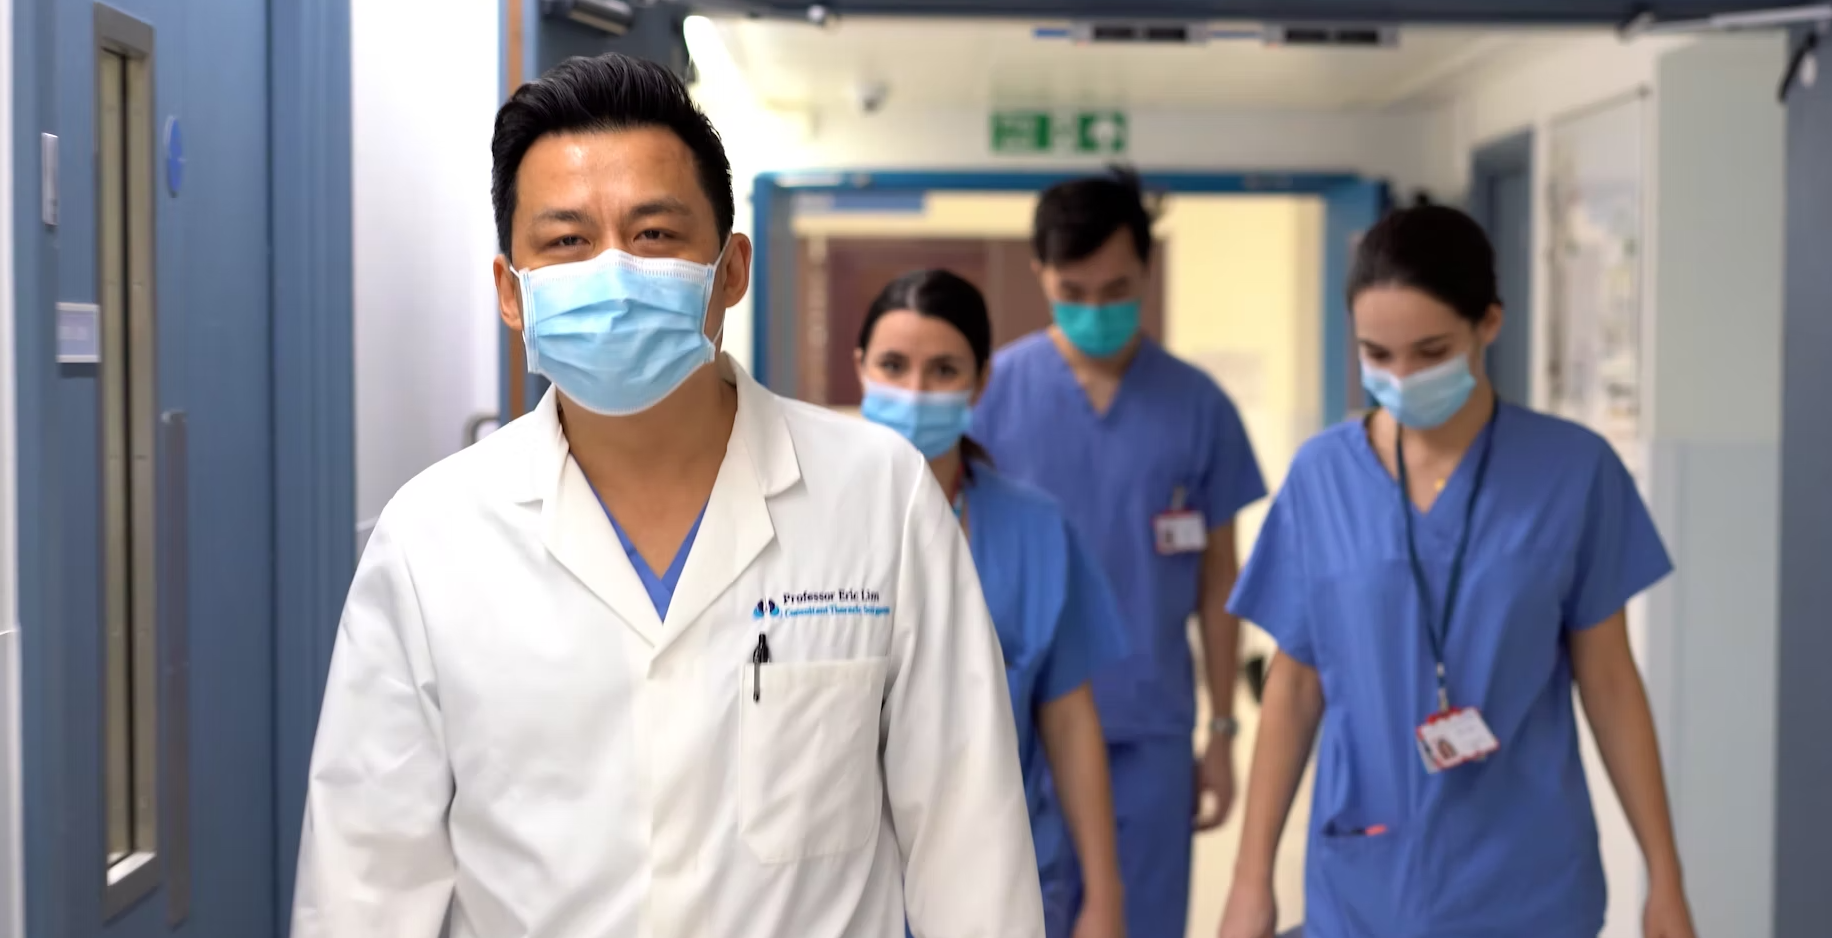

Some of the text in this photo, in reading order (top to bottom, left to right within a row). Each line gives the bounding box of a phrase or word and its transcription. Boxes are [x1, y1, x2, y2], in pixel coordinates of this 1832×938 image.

[783, 588, 880, 605] Professor Eric Lim
